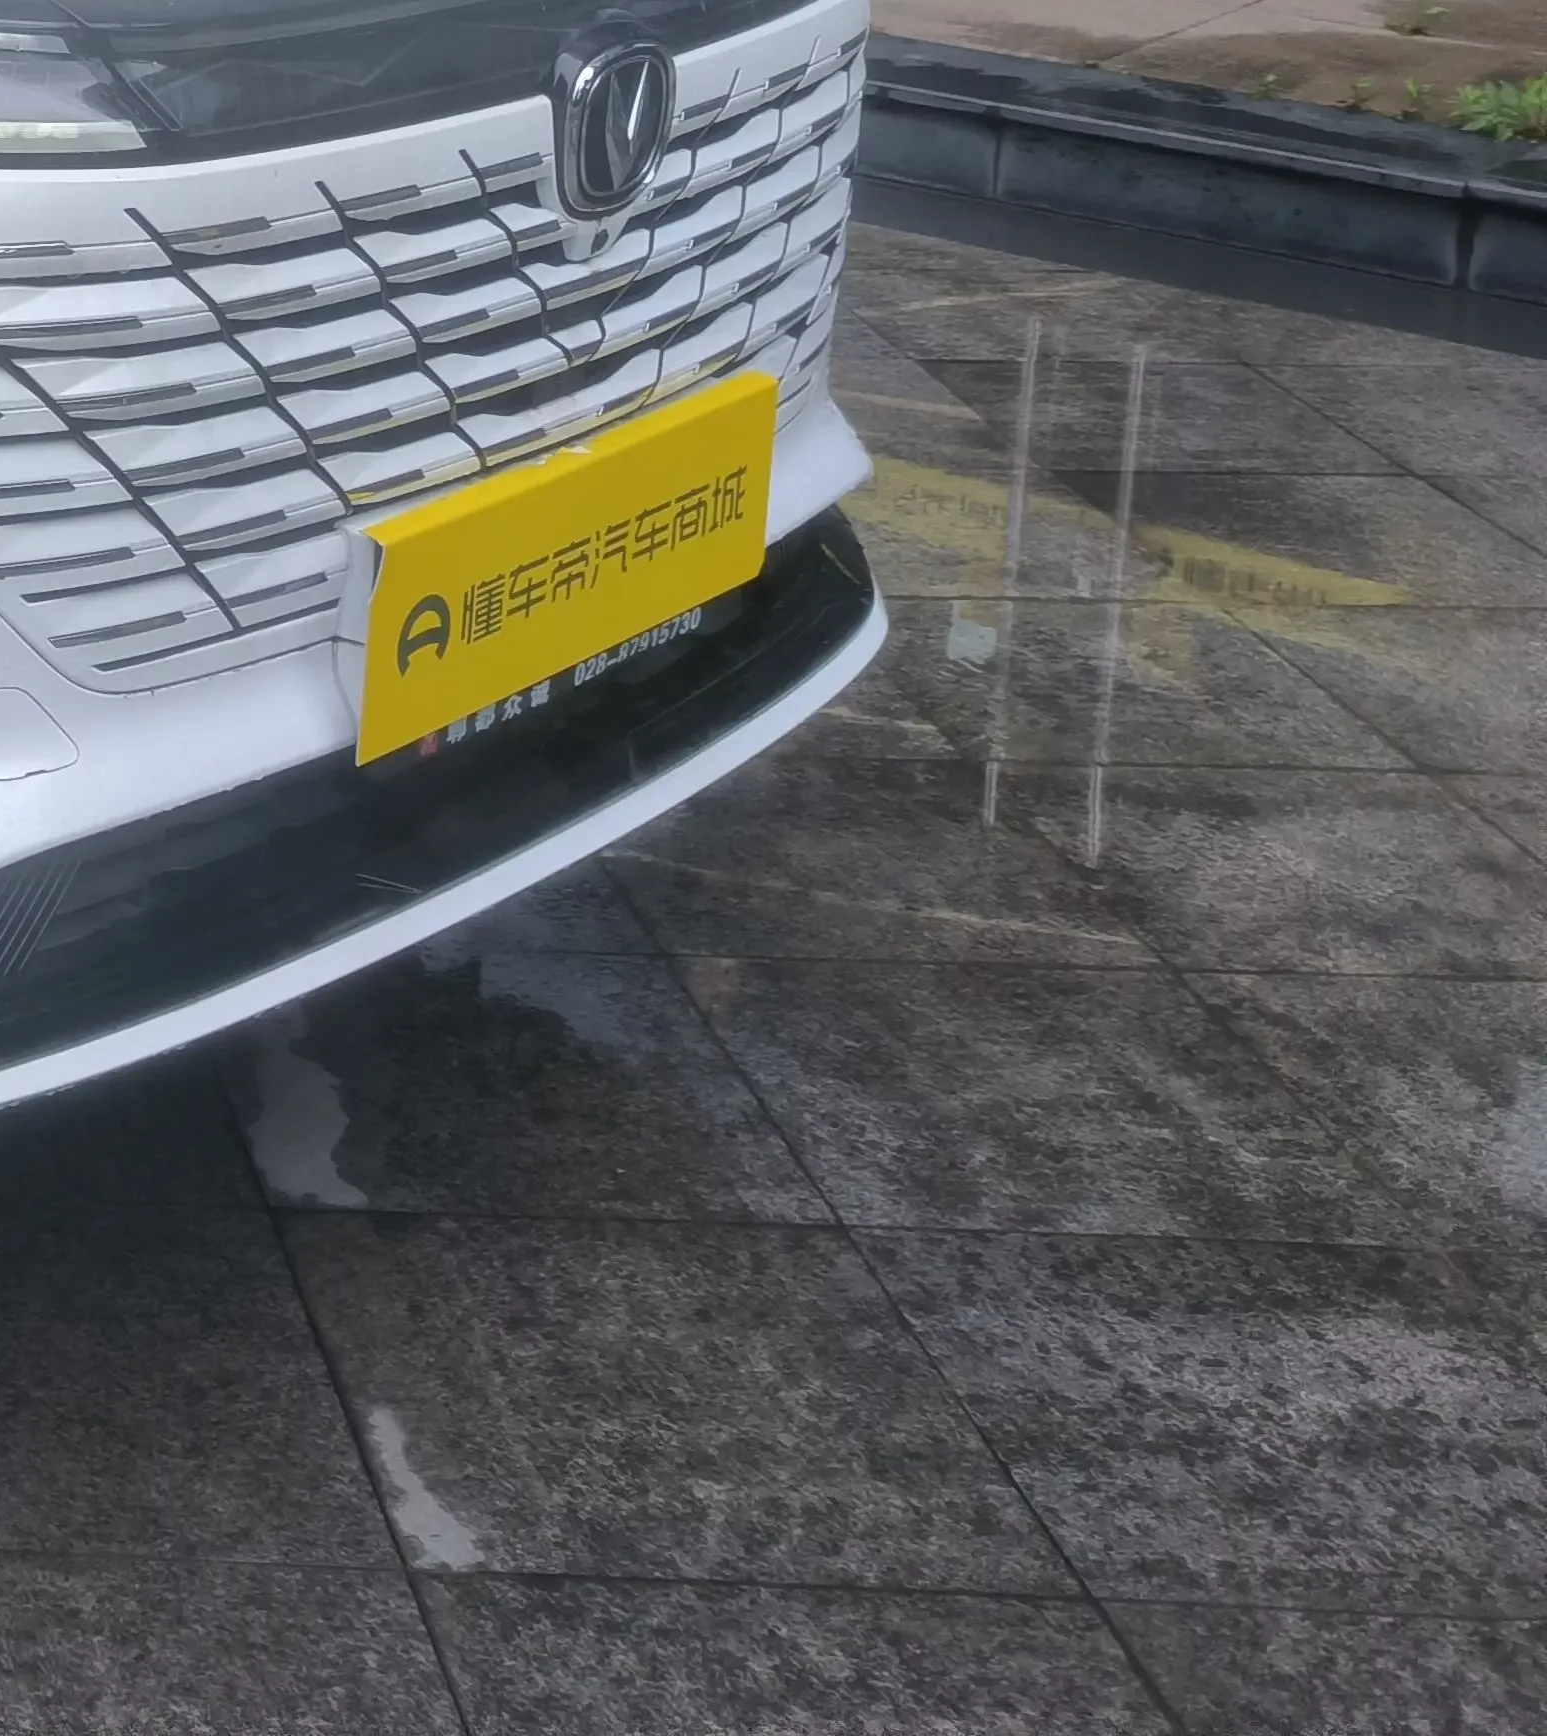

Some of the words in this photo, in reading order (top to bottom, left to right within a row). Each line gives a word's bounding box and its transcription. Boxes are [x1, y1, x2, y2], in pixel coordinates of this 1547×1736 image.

[460, 464, 749, 645] 懂车帝汽车商城
